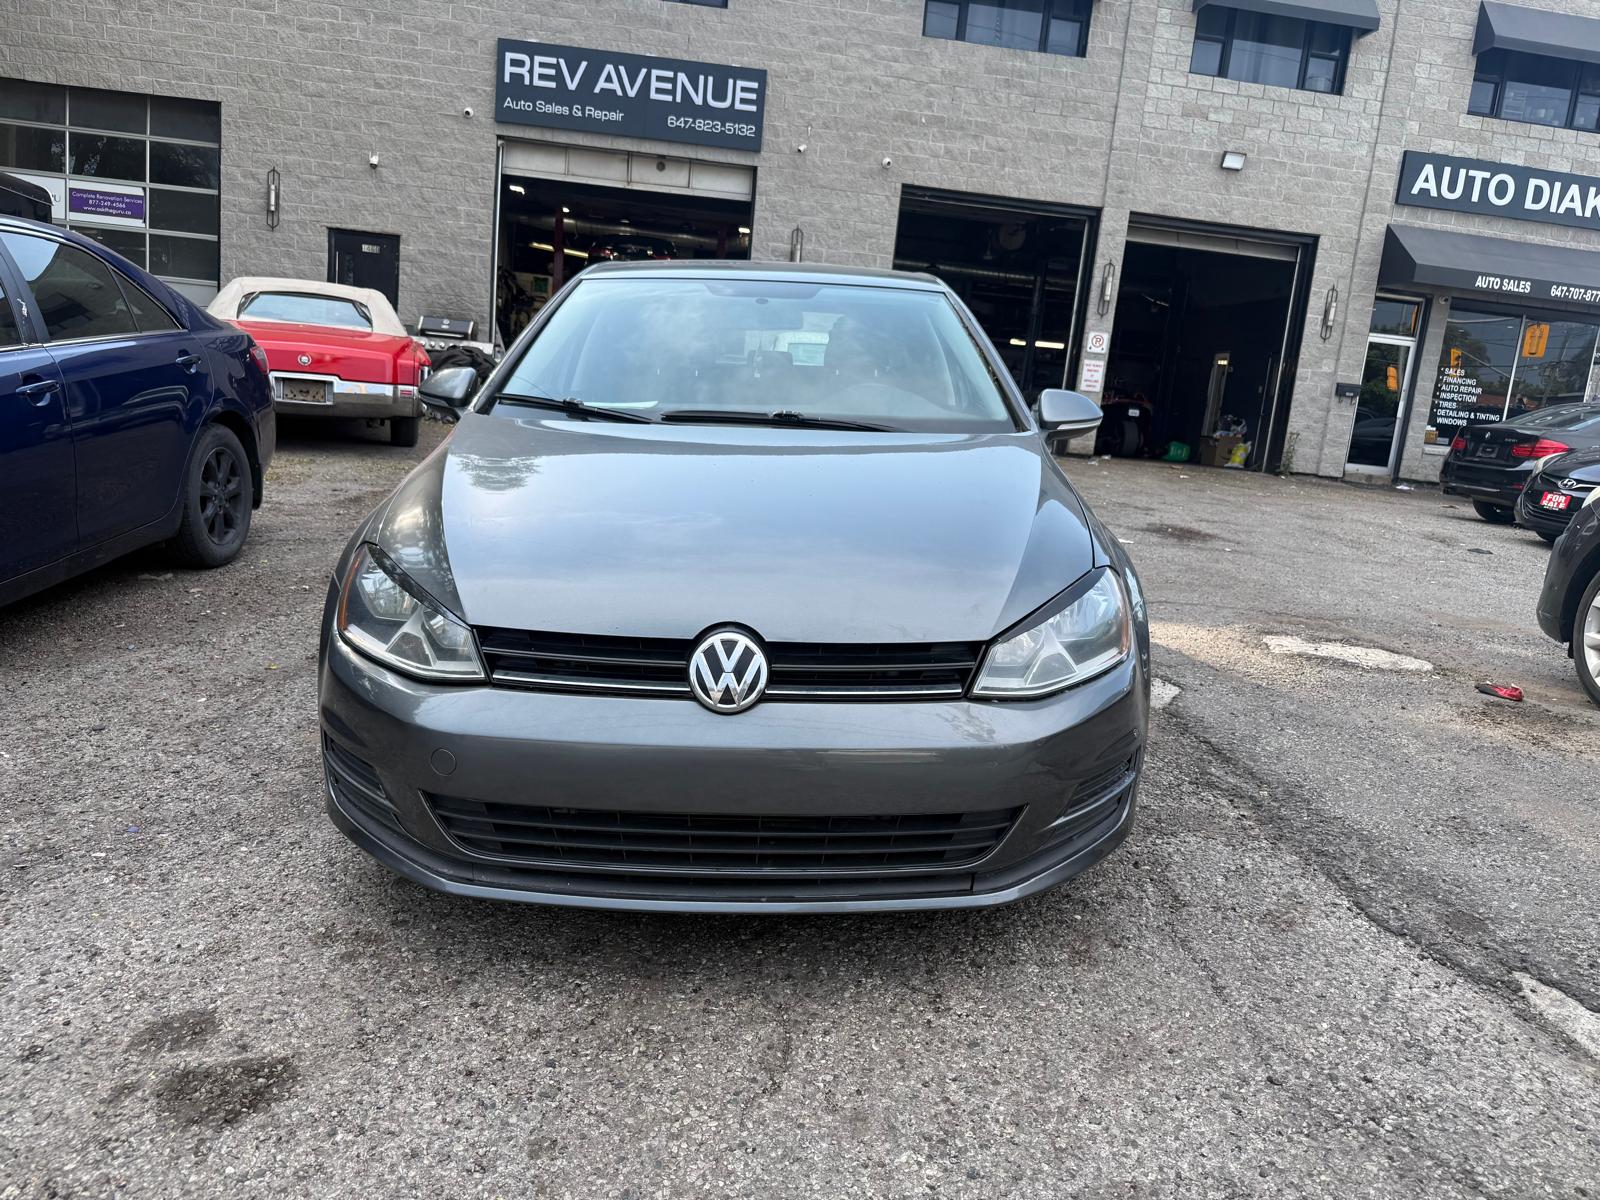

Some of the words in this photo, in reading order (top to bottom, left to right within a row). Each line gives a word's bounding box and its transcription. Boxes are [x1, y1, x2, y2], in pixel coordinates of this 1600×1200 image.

[504, 52, 588, 91] REV
[593, 64, 759, 112] AVENUE
[503, 97, 533, 111] Auto
[535, 101, 569, 115] Sales
[572, 105, 582, 117] &
[585, 107, 624, 122] Repair
[667, 116, 756, 137] 647-823-5132
[1410, 163, 1516, 206] AUTO
[1524, 178, 1600, 218] DIAK
[72, 191, 95, 199] Complete
[96, 193, 123, 202] Renovation
[123, 196, 143, 204] Services
[88, 199, 126, 208] 877-249-4566
[1475, 275, 1500, 290] AUTO
[1502, 279, 1531, 293] SALES
[1445, 367, 1465, 376] SALES
[1443, 376, 1477, 386] FINANCING
[1441, 384, 1459, 392] AUTO
[1460, 386, 1482, 395] REPAIR
[1440, 393, 1477, 403] INSPECTION
[1439, 401, 1457, 409] TIRES
[1437, 408, 1469, 419] DETAILING
[1476, 412, 1500, 422] TINTING
[1436, 417, 1467, 427] WINDOWS
[1546, 494, 1566, 503] FOR
[1542, 500, 1566, 509] SALE
